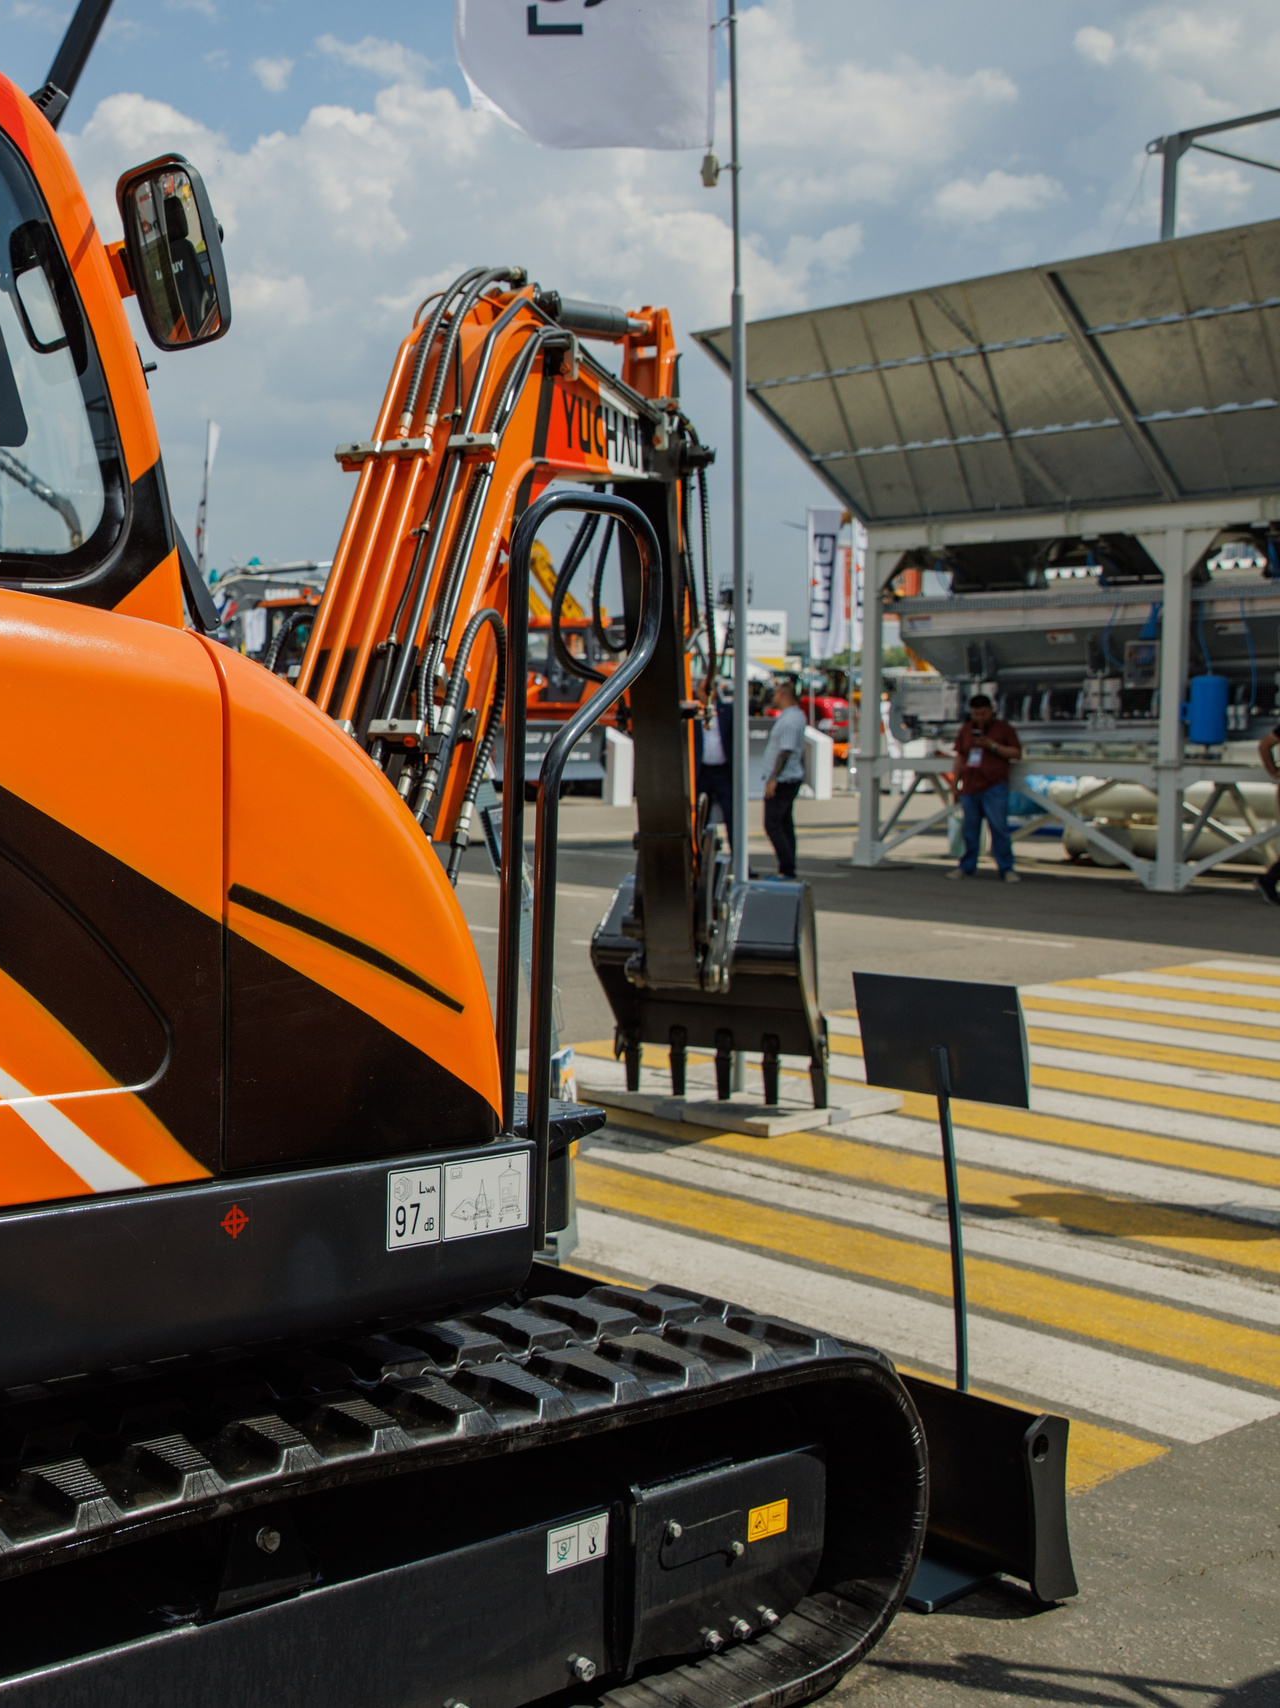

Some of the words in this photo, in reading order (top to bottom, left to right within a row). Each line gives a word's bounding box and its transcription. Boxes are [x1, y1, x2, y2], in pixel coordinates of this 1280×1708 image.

[562, 389, 639, 469] YUCHAI
[810, 533, 838, 632] UMG
[395, 1203, 421, 1238] 97
[424, 1217, 435, 1232] dB
